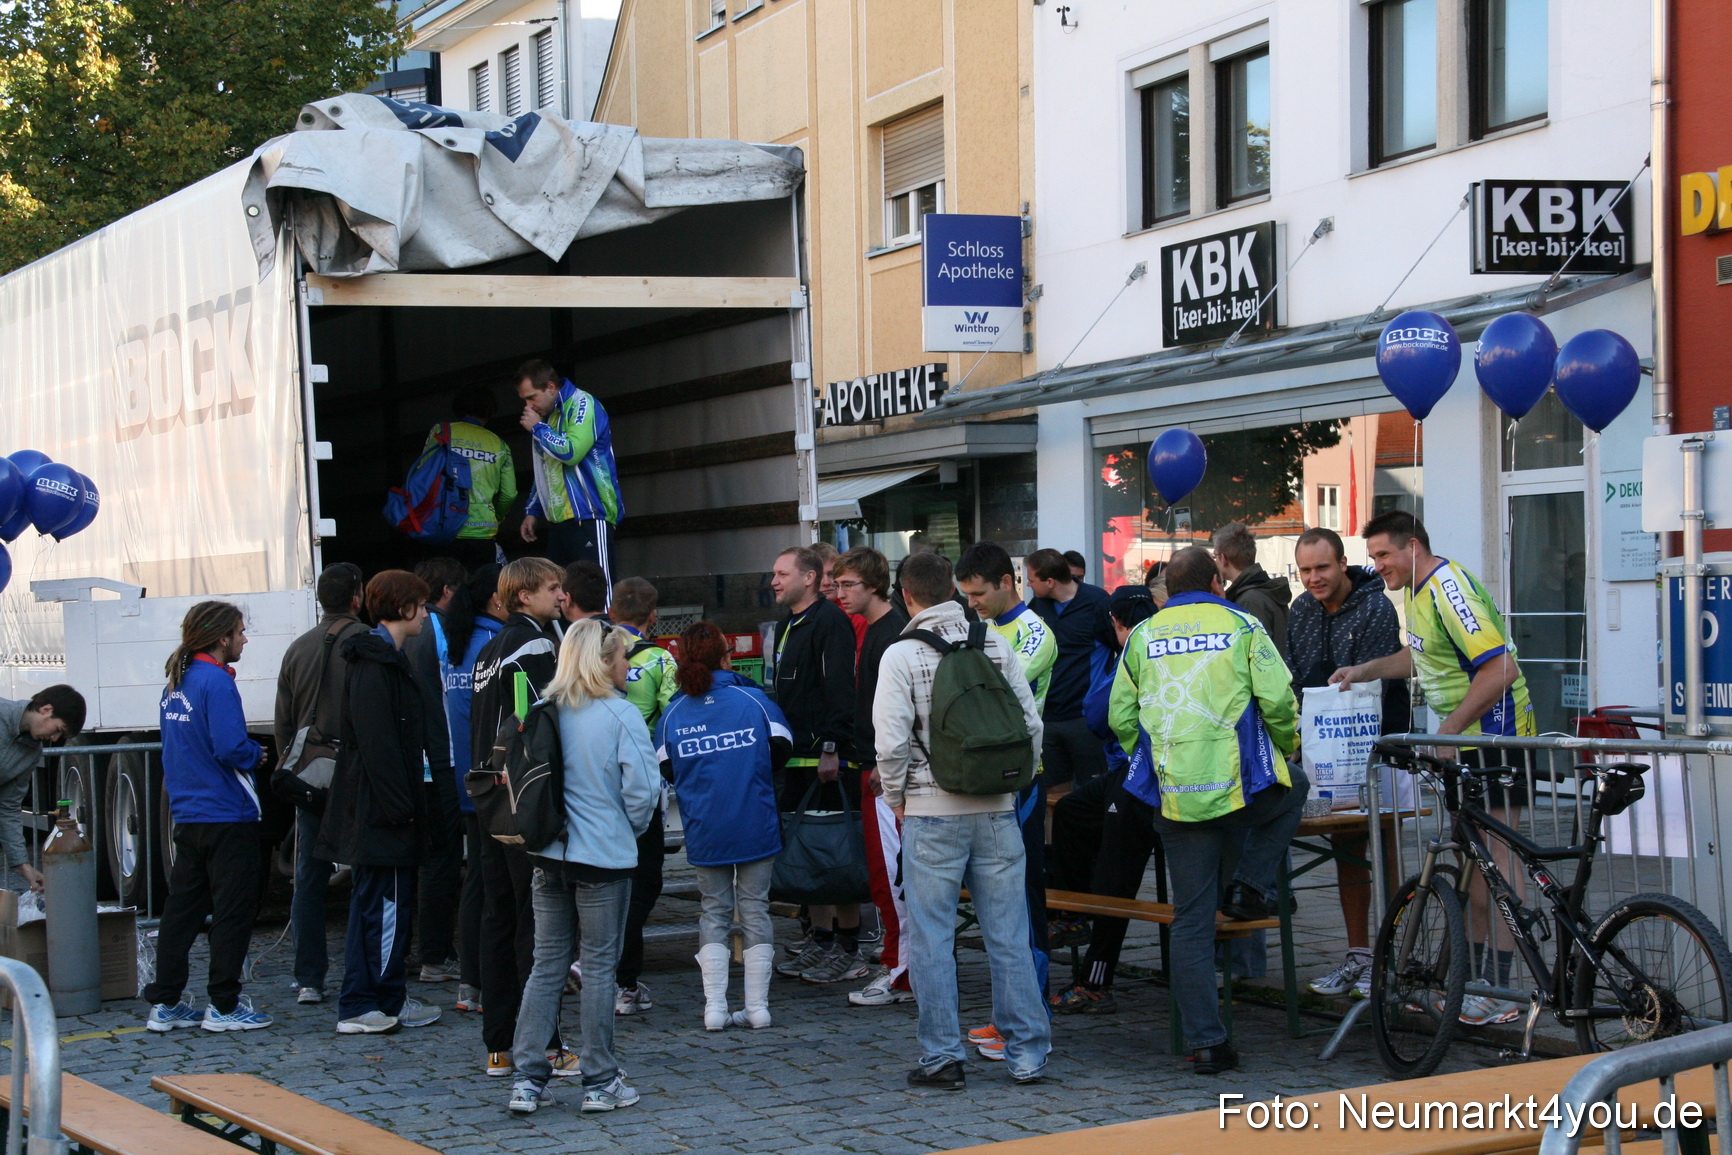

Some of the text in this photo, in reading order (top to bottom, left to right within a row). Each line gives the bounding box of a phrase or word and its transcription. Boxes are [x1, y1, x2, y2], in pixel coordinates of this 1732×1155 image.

[1492, 187, 1624, 233] KBK
[948, 241, 1004, 258] Schloss
[937, 262, 1014, 283] Apotheke
[1173, 231, 1259, 303] KBK
[954, 324, 1000, 335] Winthrop
[1386, 328, 1450, 344] BOCK
[112, 287, 256, 434] BOCK
[36, 477, 79, 497] BOCK
[1441, 578, 1482, 635] BOCK
[1150, 621, 1201, 637] TEAM
[1147, 632, 1232, 660] BOCK
[675, 724, 707, 736] TEAM
[677, 728, 757, 758] BOCK
